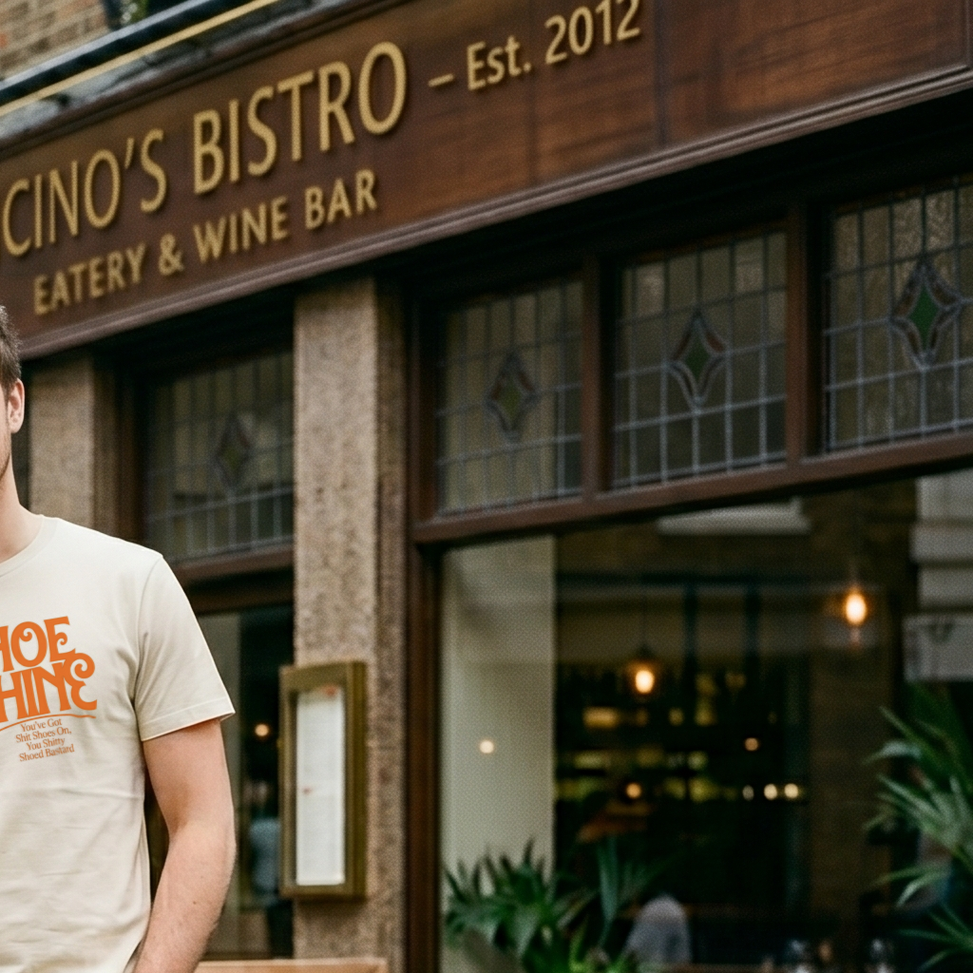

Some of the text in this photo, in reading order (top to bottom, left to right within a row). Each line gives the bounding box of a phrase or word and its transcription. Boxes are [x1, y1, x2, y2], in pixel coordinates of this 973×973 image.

[193, 42, 407, 194] BISTRO
[466, 36, 532, 90] Est.
[544, 0, 641, 65] 2012
[34, 169, 377, 315] EATERY & WINE BAR
[20, 718, 62, 732] You've Got
[15, 733, 31, 743] Shit
[32, 730, 55, 740] Shoes
[26, 738, 65, 750] You Shitty
[19, 744, 75, 761] Shoed Bastard
